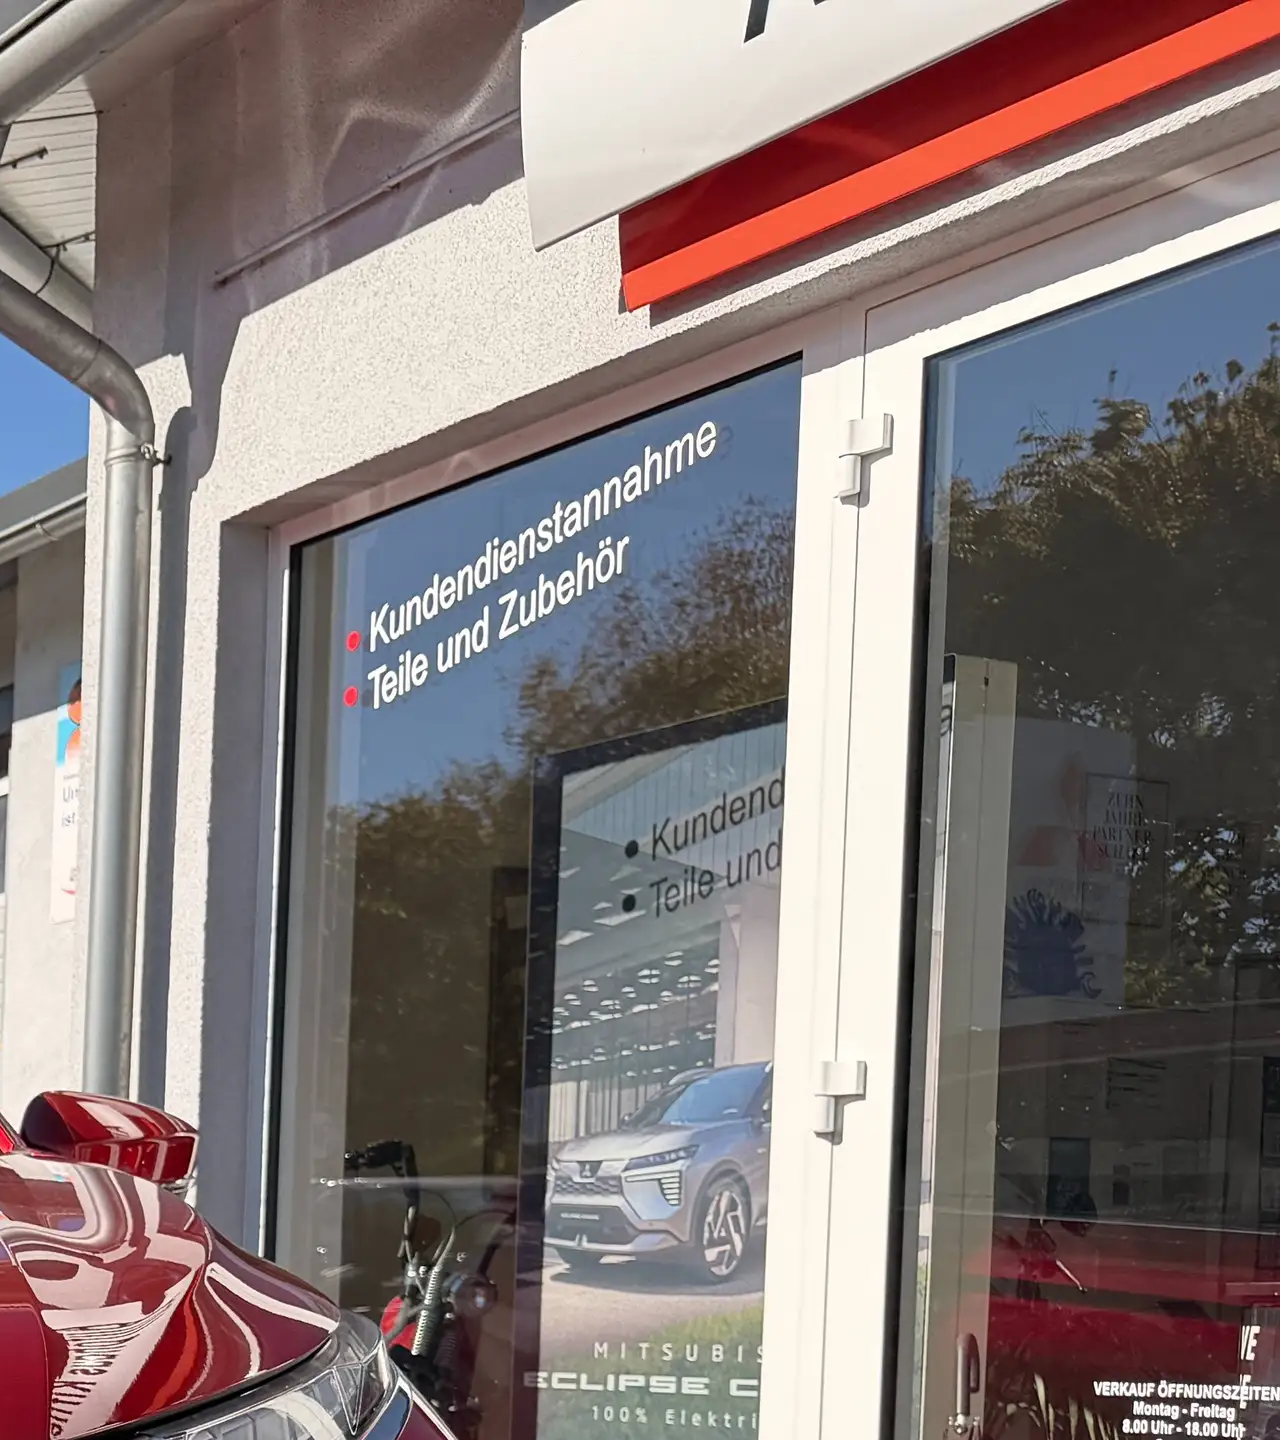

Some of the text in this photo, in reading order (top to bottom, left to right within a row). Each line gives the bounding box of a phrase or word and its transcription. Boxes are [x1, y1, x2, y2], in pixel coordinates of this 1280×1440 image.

[369, 421, 717, 652] Kundendienstannahme
[368, 536, 629, 709] Teile und Zubehör
[649, 867, 715, 918] Teile
[523, 1371, 710, 1396] ECLIPSE
[1093, 1381, 1155, 1398] VERKAUF
[1157, 1380, 1280, 1401] ÖFFNUNGSZEITEN
[592, 1405, 757, 1430] 100% Elektri
[1133, 1401, 1179, 1420] Montag
[1190, 1403, 1235, 1421] Freitag
[1122, 1419, 1148, 1434] 8.00
[1150, 1420, 1174, 1435] Uhr
[1185, 1422, 1218, 1437] 18.00
[1221, 1423, 1246, 1438] Uhr
